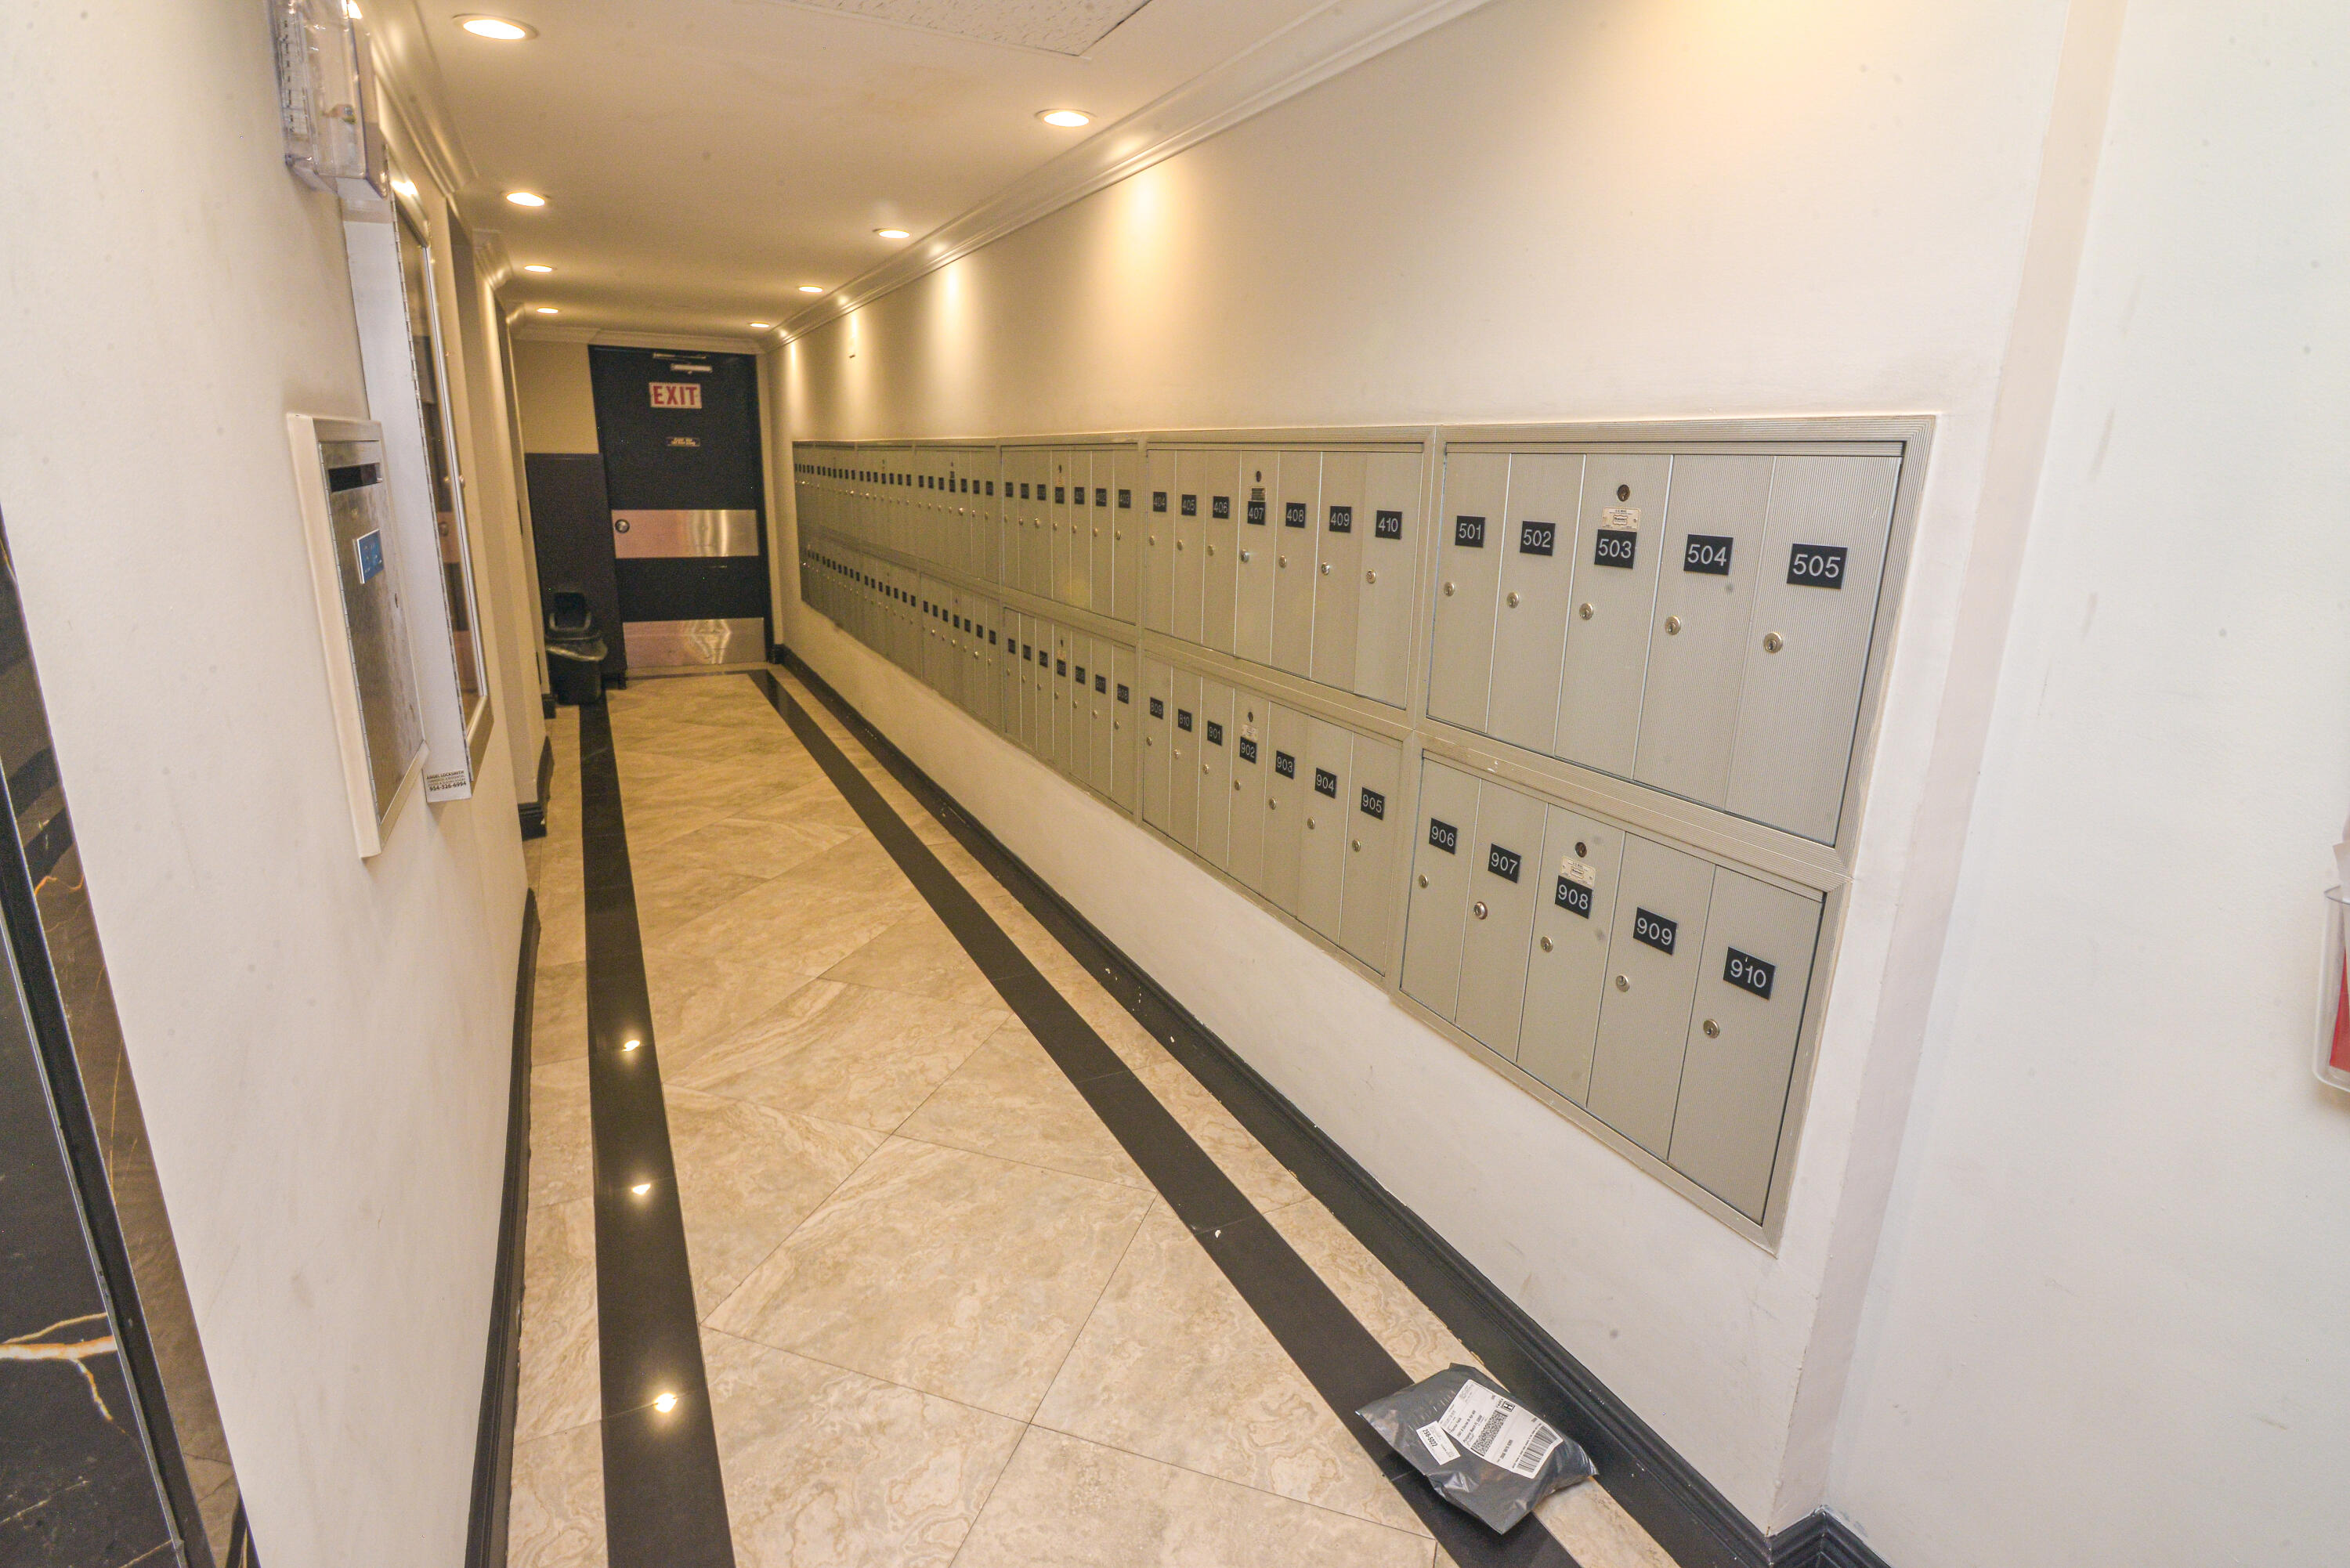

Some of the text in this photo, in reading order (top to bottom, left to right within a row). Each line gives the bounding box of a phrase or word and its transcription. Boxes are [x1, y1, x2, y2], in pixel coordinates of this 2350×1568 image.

[653, 385, 697, 405] EXIT
[1153, 497, 1166, 507] 404
[1182, 500, 1195, 509] 405
[1214, 502, 1227, 514] 406
[1248, 508, 1264, 520] 407
[1286, 509, 1304, 522] 408
[1330, 512, 1350, 526] 409
[1378, 518, 1398, 533] 410
[1459, 523, 1481, 540] 501
[1523, 529, 1551, 548] 502
[1597, 539, 1632, 558] 503
[1687, 544, 1726, 565] 504
[1792, 554, 1841, 578] 505
[1151, 702, 1162, 715] 809
[1179, 714, 1190, 726] 810
[1209, 727, 1221, 739] 901
[1242, 742, 1255, 758] 902
[1277, 757, 1292, 773] 903
[1316, 775, 1334, 792] 904
[1362, 795, 1382, 813] 905
[1431, 826, 1455, 847] 906
[1491, 852, 1517, 874] 907
[1558, 884, 1589, 909] 908
[1636, 918, 1672, 946] 909
[1730, 959, 1766, 988] 910
